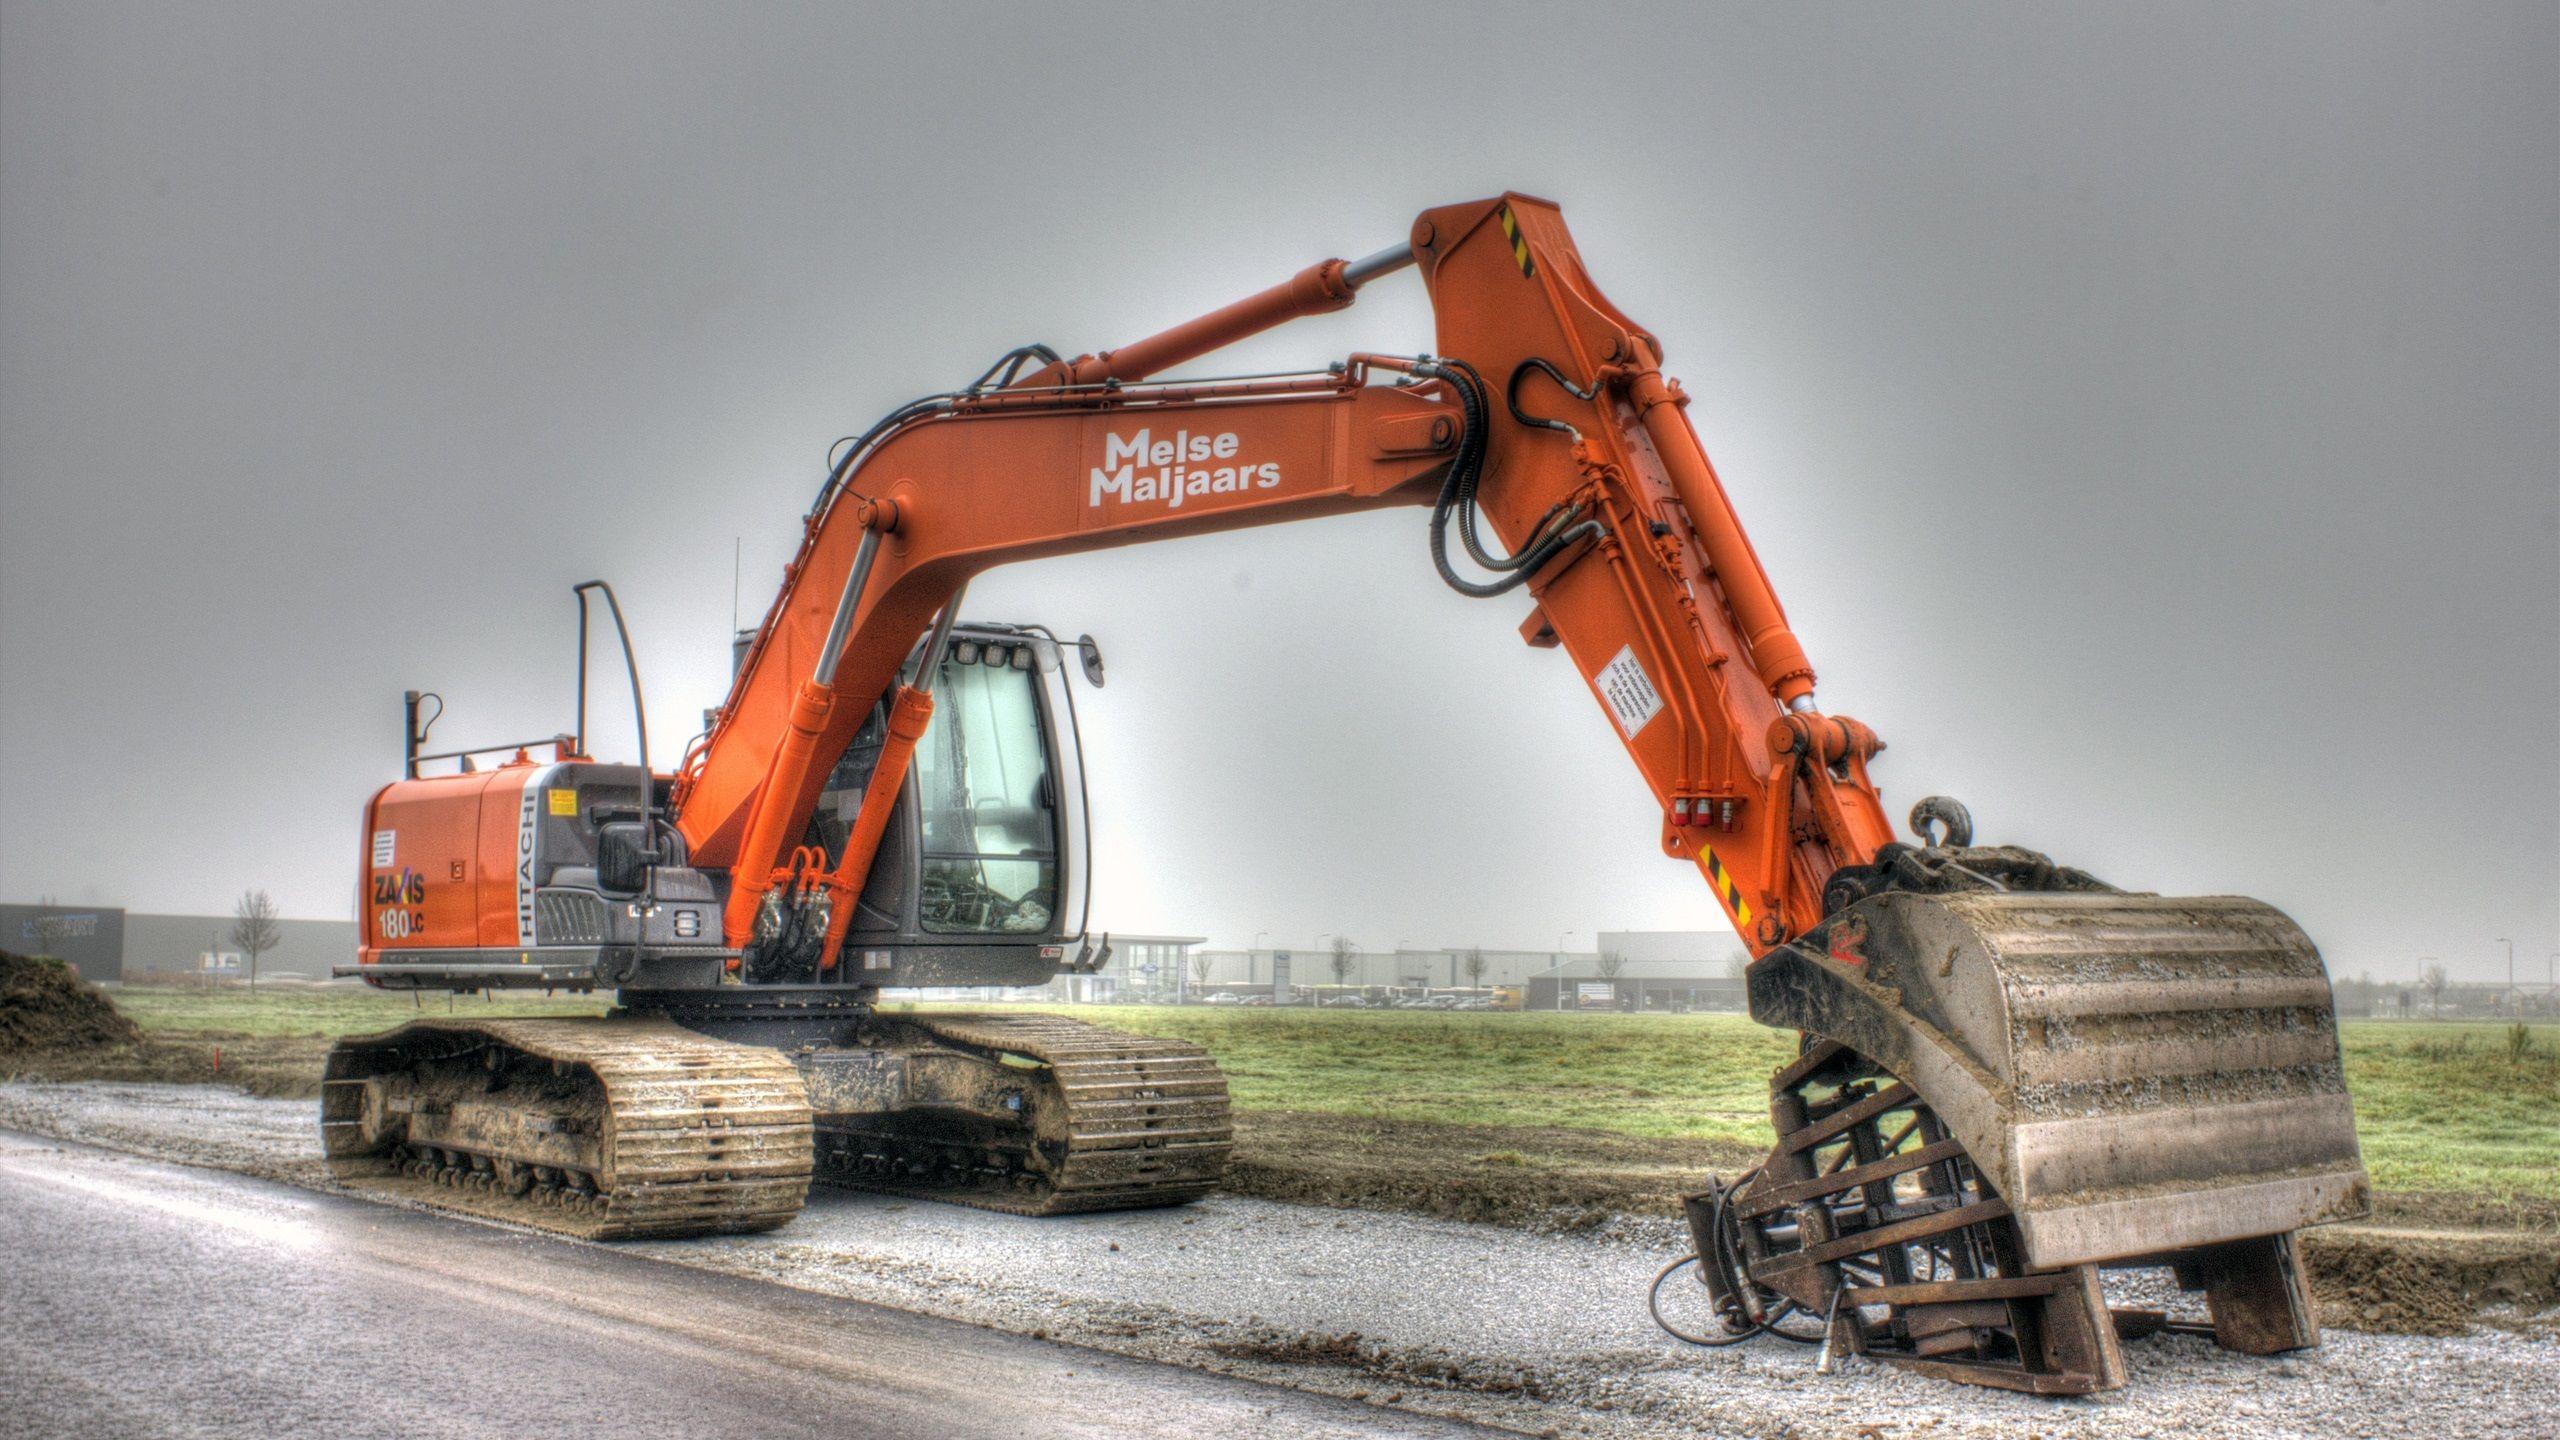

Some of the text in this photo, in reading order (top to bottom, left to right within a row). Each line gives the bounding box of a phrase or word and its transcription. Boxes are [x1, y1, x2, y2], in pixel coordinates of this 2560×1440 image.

[1105, 428, 1239, 472] Melse
[1089, 463, 1281, 508] Maljaars
[375, 867, 425, 904] ZAXIS
[521, 795, 535, 937] HITACHI
